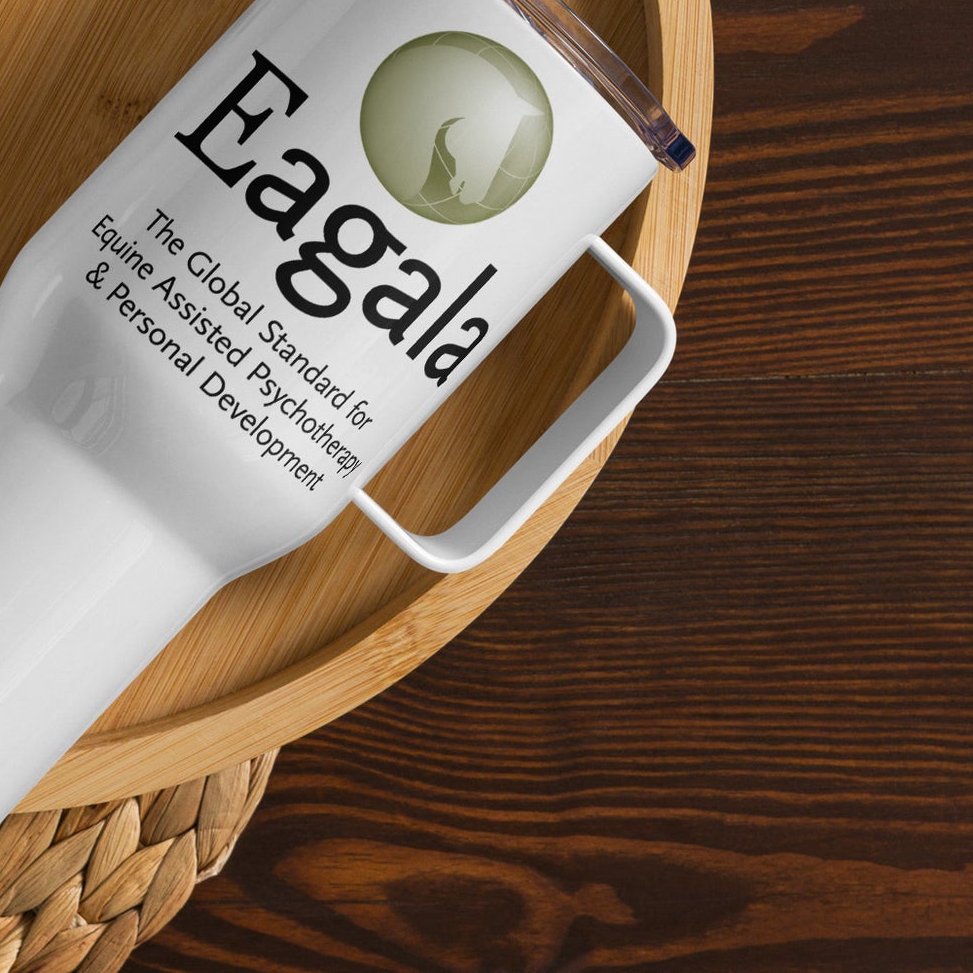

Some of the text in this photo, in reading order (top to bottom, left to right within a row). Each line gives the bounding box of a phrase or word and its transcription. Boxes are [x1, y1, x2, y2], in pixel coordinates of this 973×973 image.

[146, 208, 373, 430] The Global Standard for
[173, 49, 498, 388] Eagala
[85, 261, 325, 491] & Personal Development
[91, 214, 363, 479] Equine Assisted Psychotherapy
